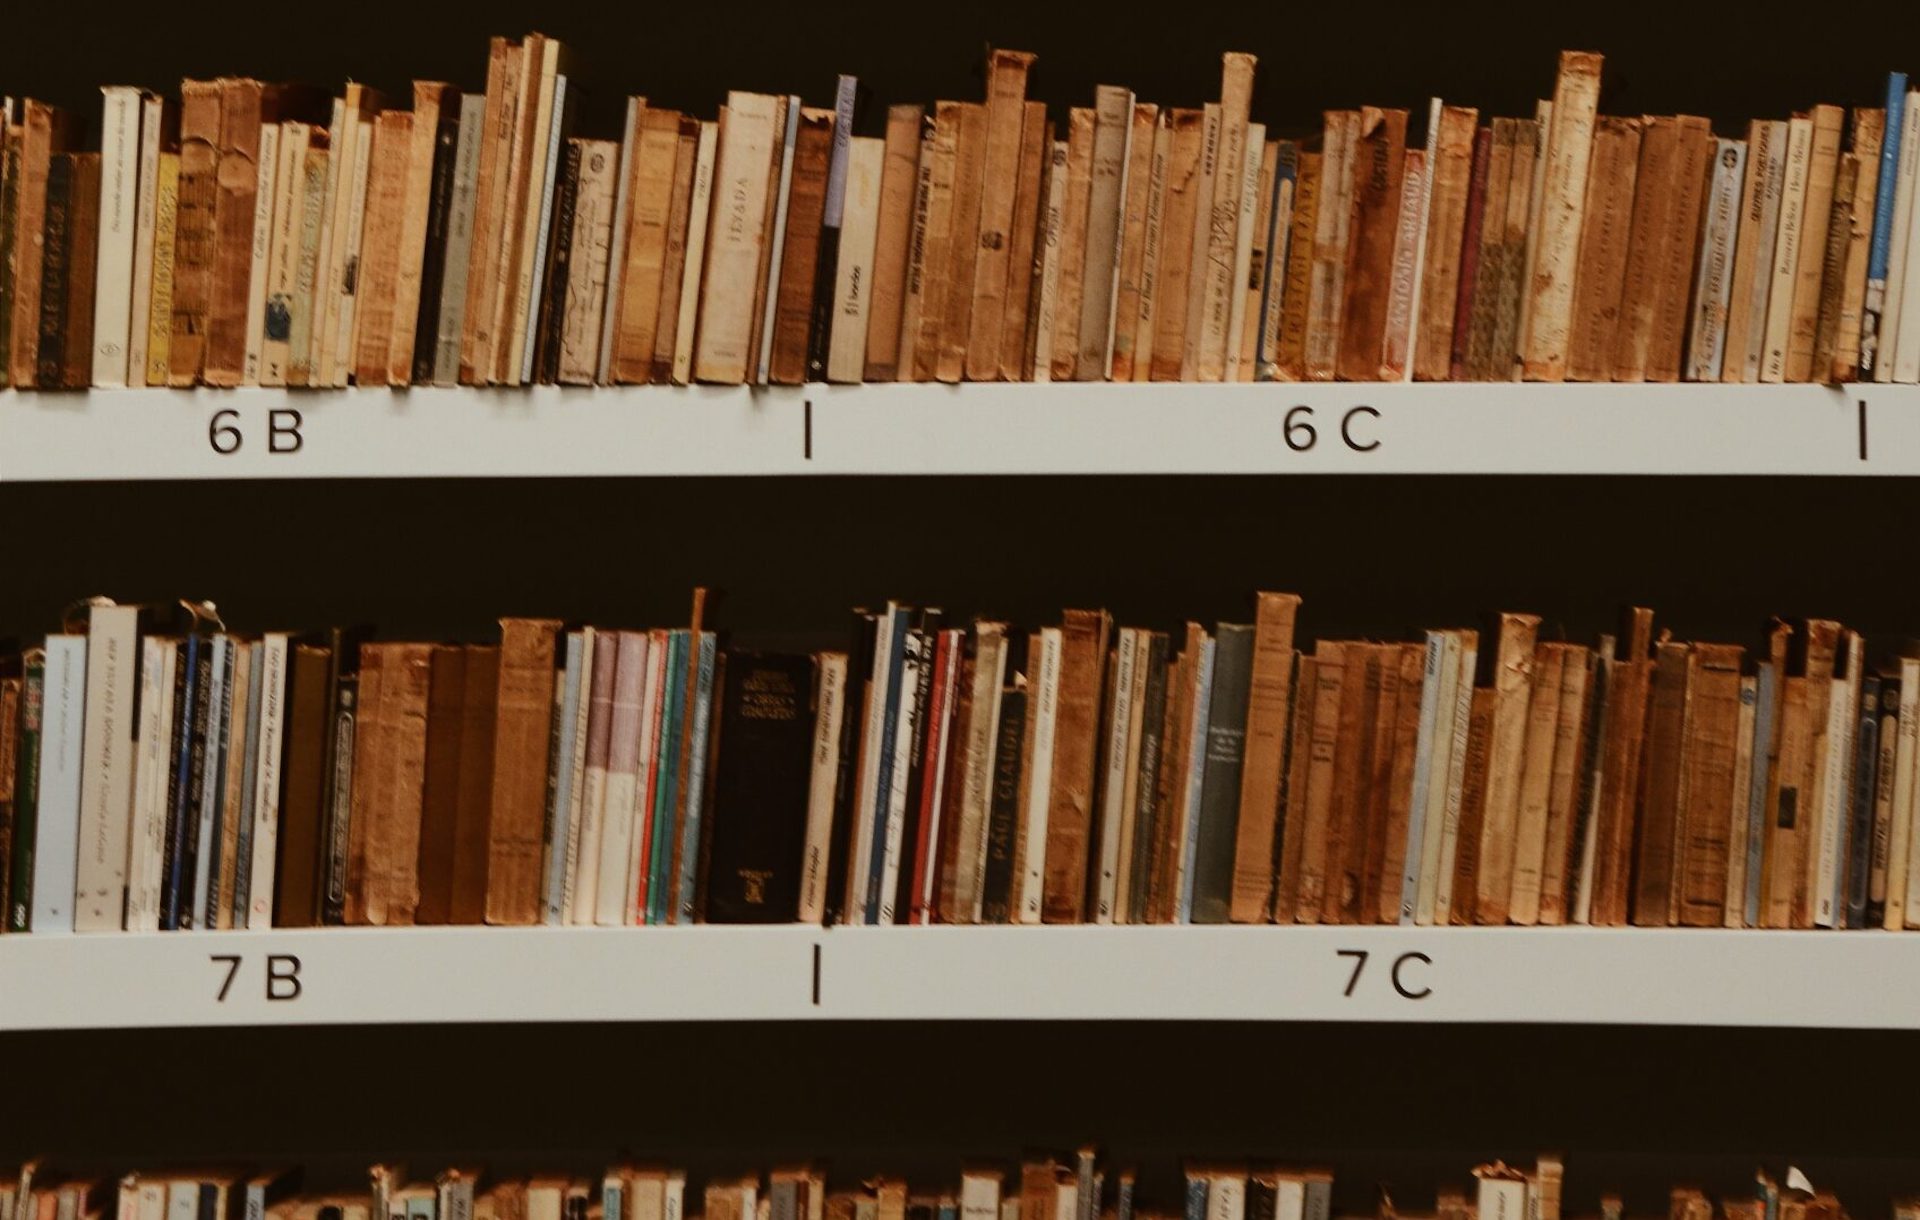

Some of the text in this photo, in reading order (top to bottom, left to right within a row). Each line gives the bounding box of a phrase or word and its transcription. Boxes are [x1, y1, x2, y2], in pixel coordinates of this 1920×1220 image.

[1286, 255, 1307, 345] TRISTAN
[209, 408, 303, 454] 6 B
[1283, 405, 1382, 452] 6 C
[990, 811, 1012, 860] PAUL
[210, 954, 302, 1001] 7 B
[1336, 949, 1433, 1000] 7 C
